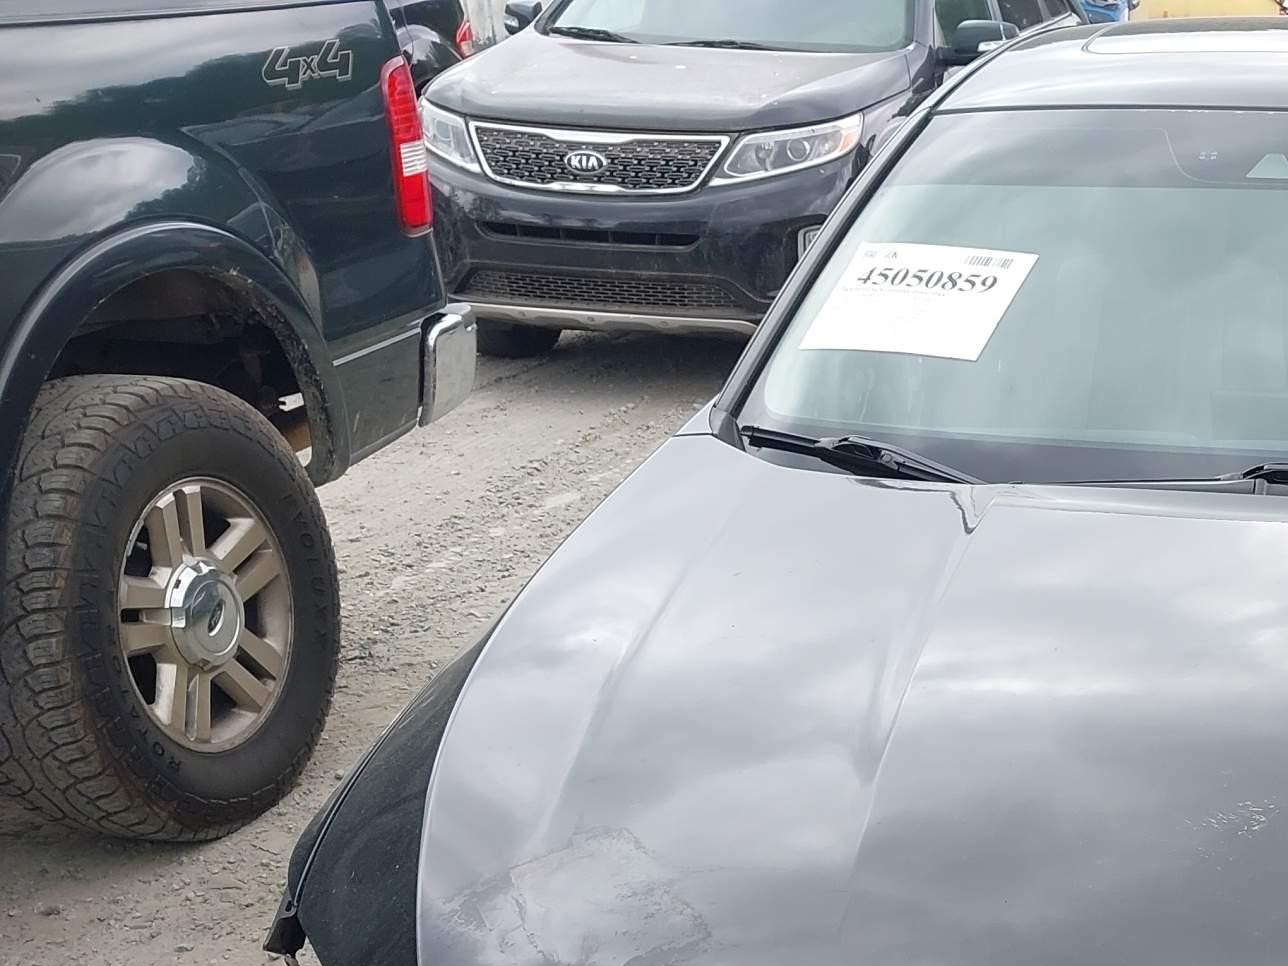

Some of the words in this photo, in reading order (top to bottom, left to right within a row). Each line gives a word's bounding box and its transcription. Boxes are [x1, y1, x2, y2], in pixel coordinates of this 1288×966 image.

[262, 39, 352, 90] 4x4
[571, 155, 599, 170] KIA
[856, 266, 999, 295] 45050859
